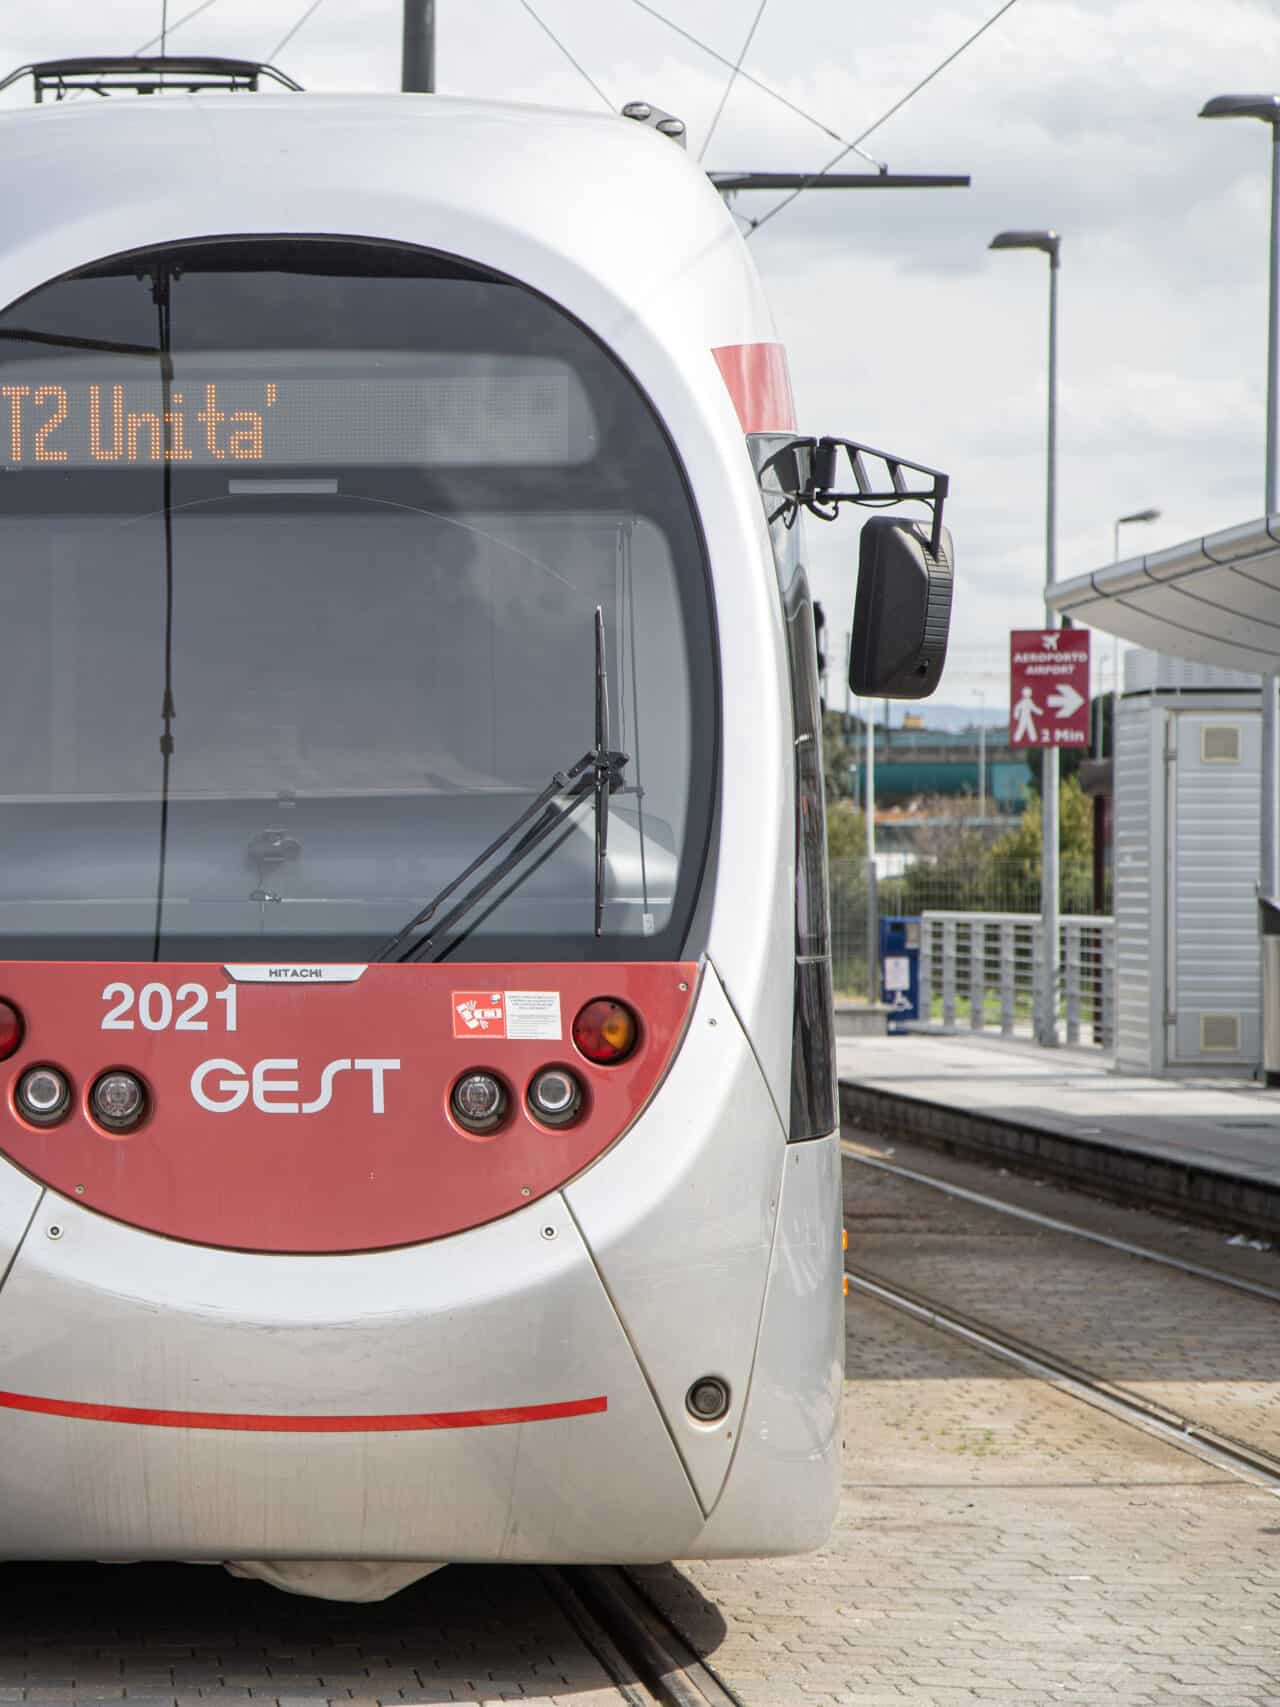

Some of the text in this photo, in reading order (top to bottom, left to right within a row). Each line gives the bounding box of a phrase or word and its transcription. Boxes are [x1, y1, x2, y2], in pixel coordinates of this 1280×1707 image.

[2, 383, 276, 461] T2 Unita'
[1014, 652, 1088, 662] AEROPORTO
[1025, 664, 1074, 674] AIRPORT
[1054, 729, 1084, 742] Min
[269, 967, 322, 978] HITACHI
[100, 982, 237, 1031] 2021
[190, 1058, 401, 1114] GEST
